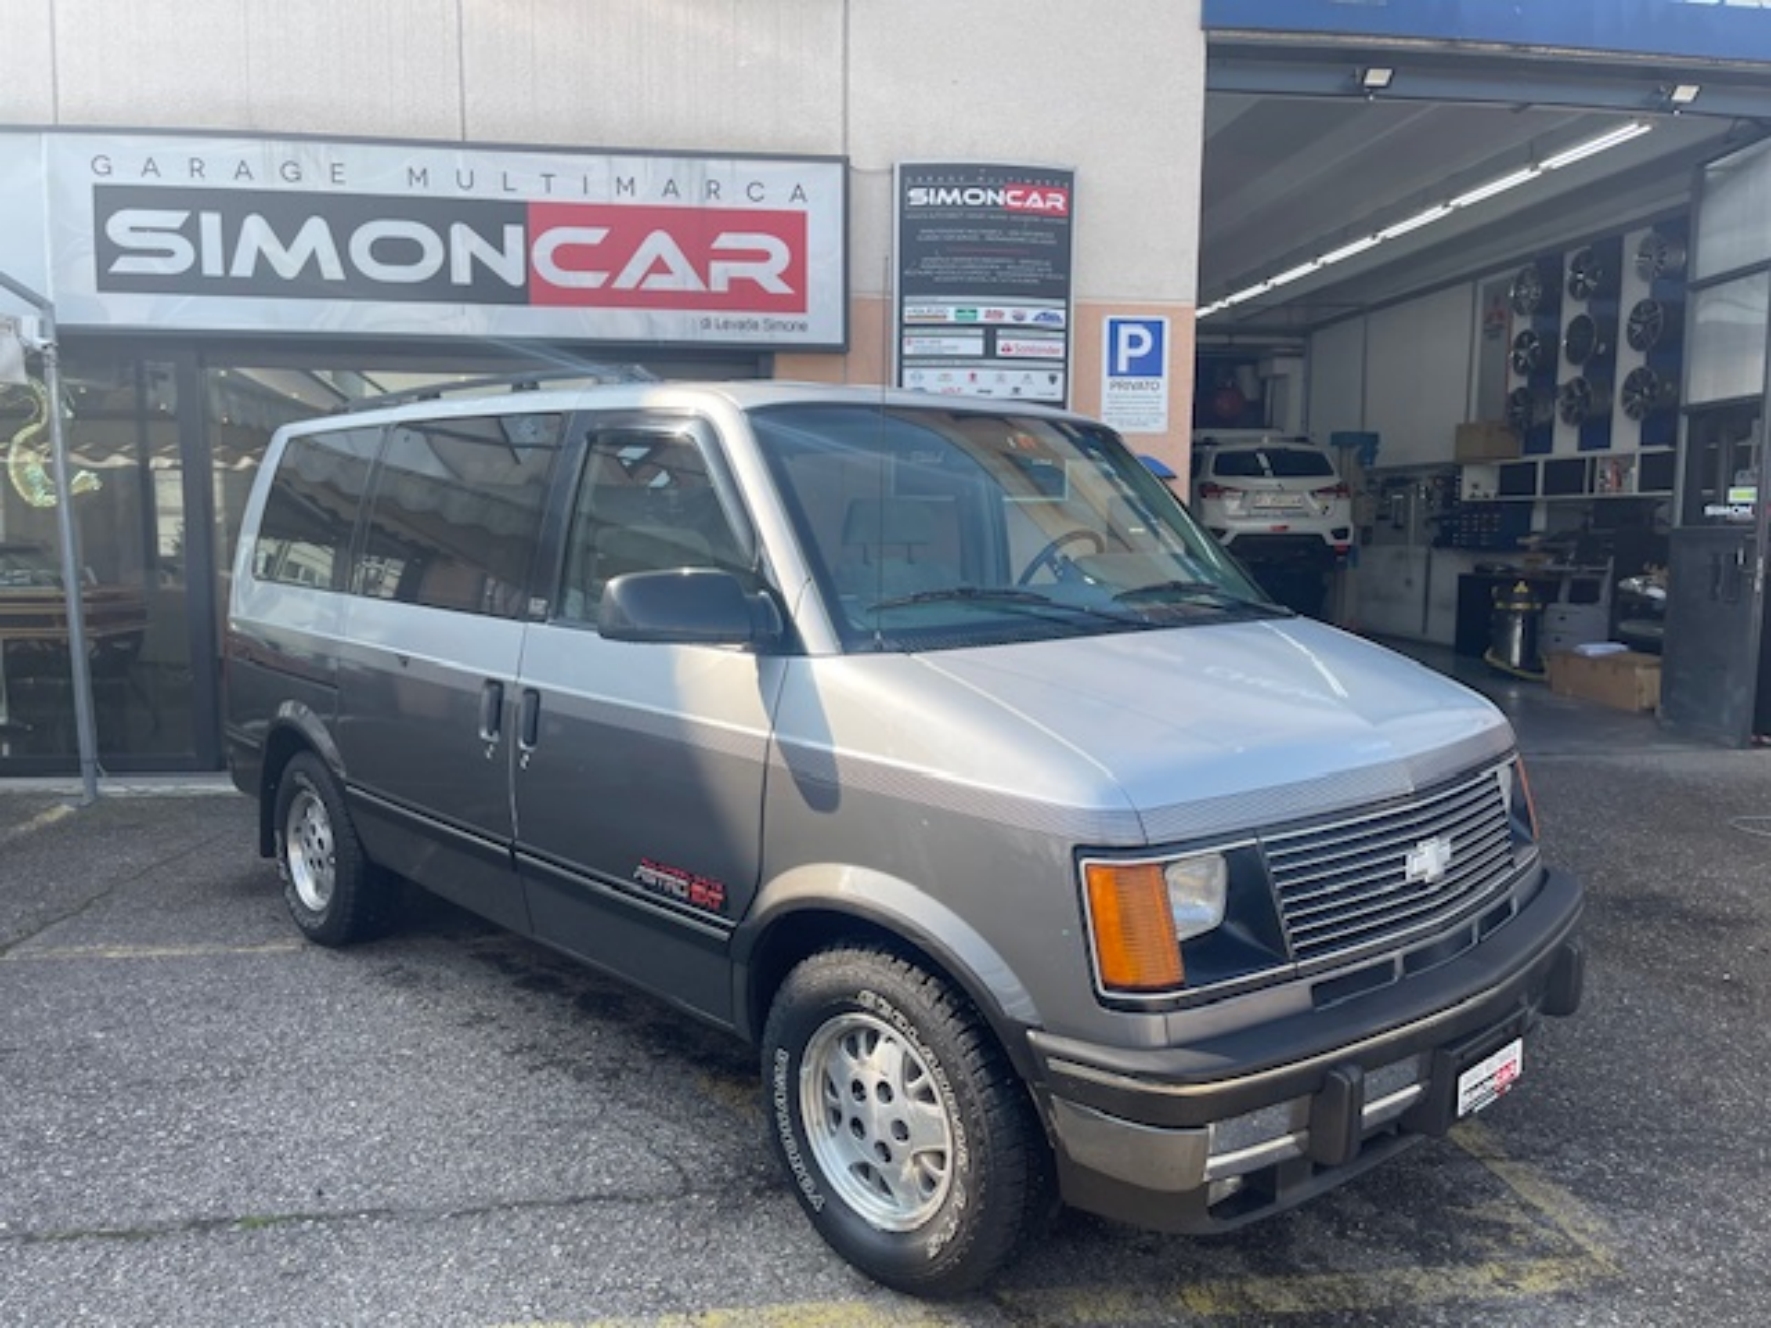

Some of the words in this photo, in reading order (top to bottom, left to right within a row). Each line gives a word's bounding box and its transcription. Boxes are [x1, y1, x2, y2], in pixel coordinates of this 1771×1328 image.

[91, 154, 347, 184] GARAGE
[408, 166, 809, 203] MULTIMARCA
[105, 208, 796, 295] SIMONCAR
[762, 317, 808, 333] Simone
[1117, 322, 1152, 372] P
[1109, 380, 1160, 391] PRIVATO
